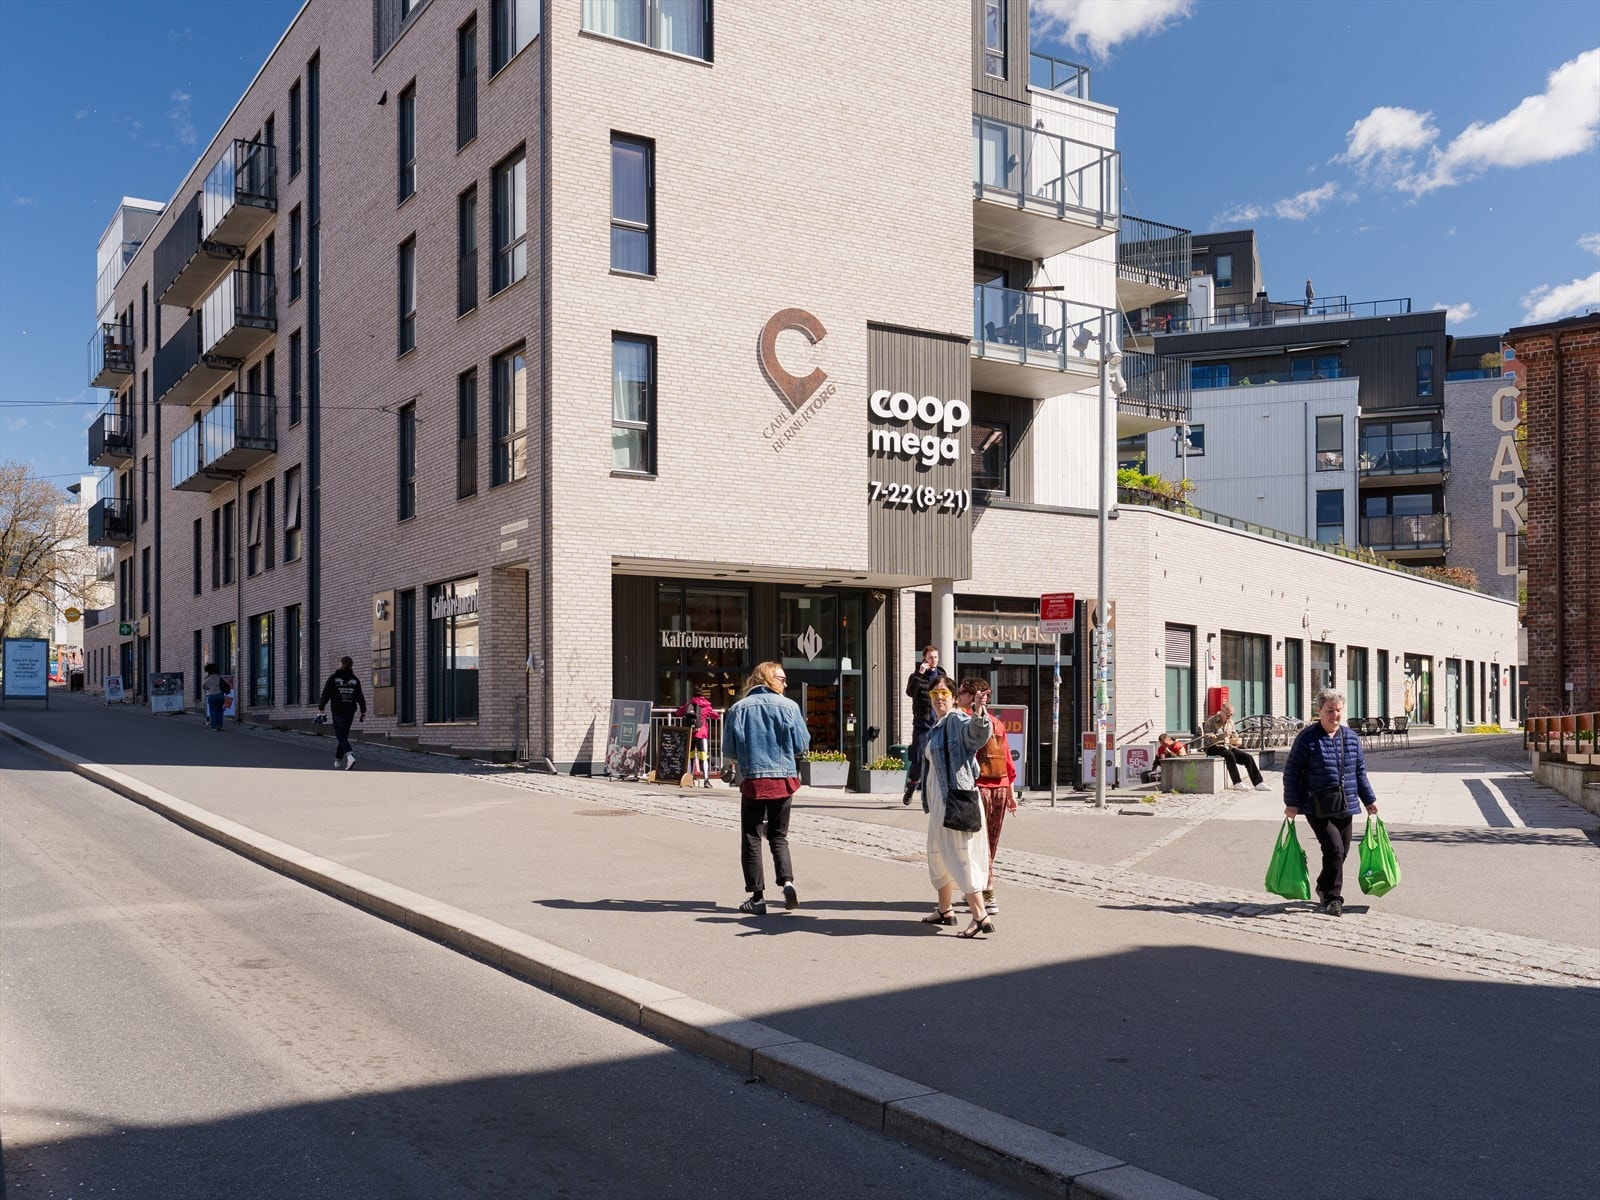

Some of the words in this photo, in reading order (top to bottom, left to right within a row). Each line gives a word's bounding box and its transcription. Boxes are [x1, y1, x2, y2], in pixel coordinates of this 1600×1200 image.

[762, 409, 791, 440] CARL
[771, 383, 837, 454] BERNERTORG
[869, 389, 970, 433] coop
[871, 429, 960, 467] mega
[870, 481, 914, 504] 7-22
[916, 484, 970, 512] (8-21)
[1489, 386, 1525, 576] CARL
[662, 630, 749, 650] Kaffebrenneriet
